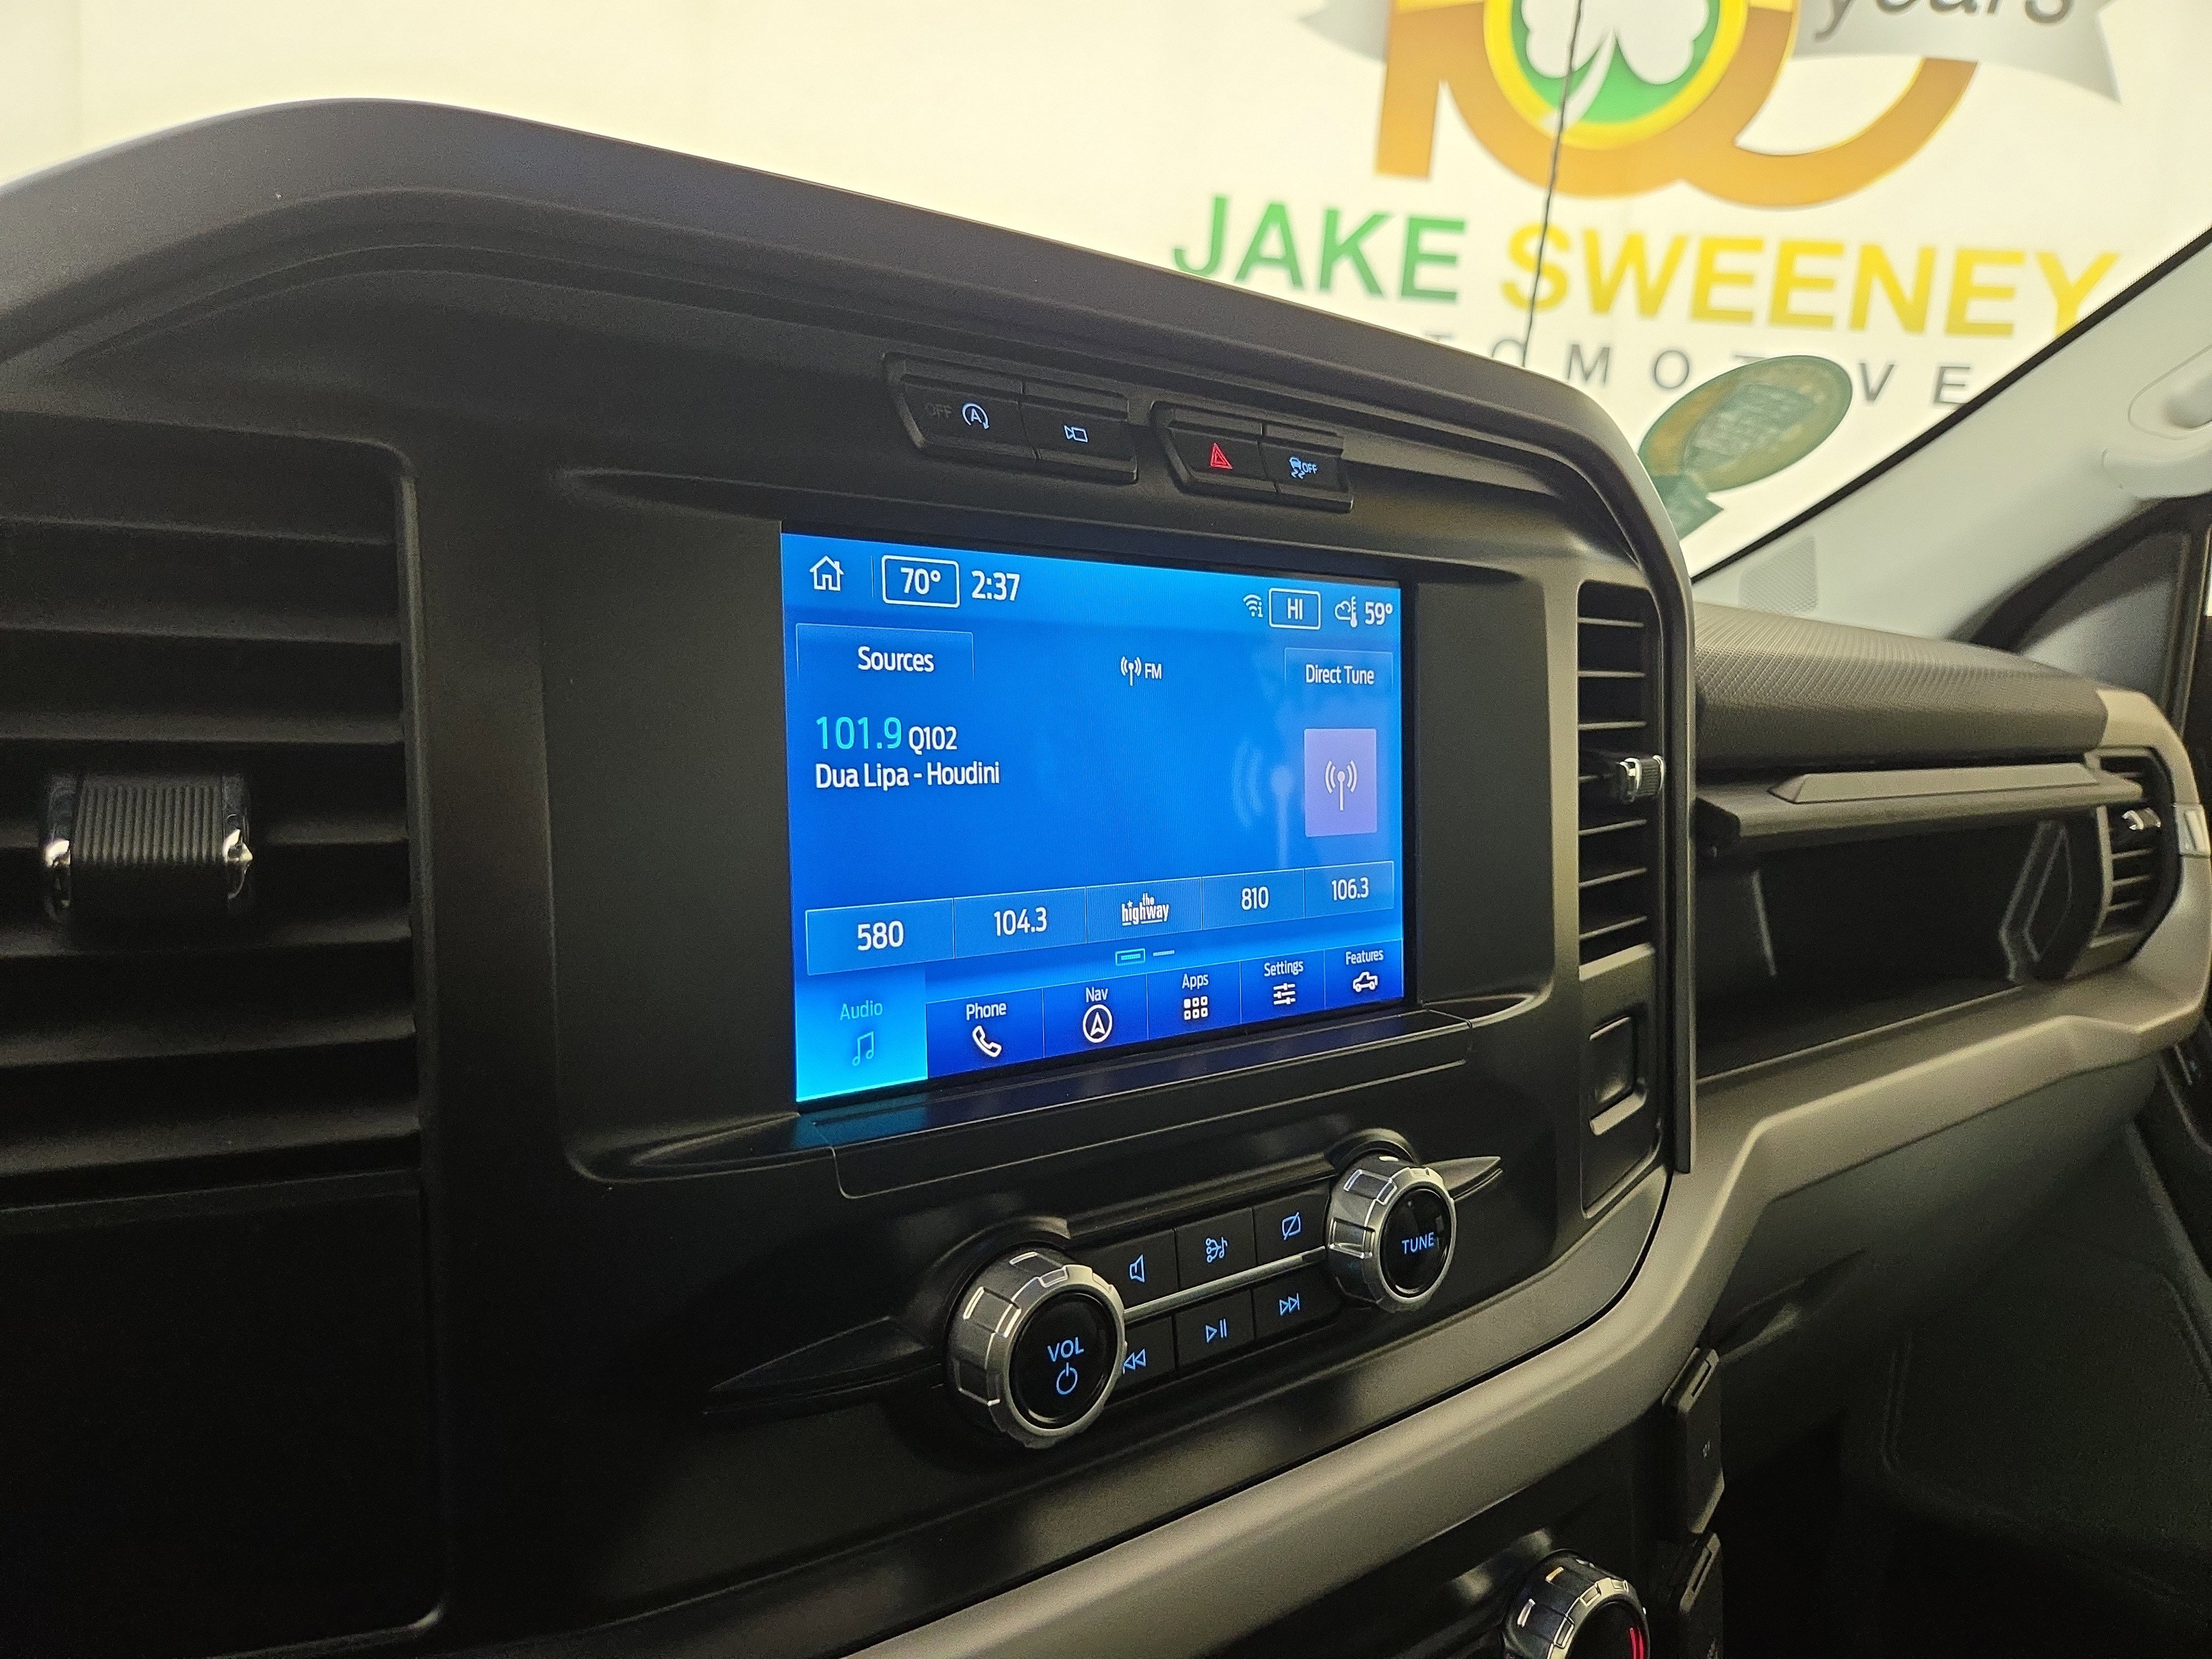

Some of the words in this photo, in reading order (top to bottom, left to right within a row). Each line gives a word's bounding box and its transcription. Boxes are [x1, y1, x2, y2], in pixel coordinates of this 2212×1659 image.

[1173, 196, 1467, 303] JAKE
[1500, 222, 2121, 337] SWEENEY
[1302, 462, 1317, 474] OFF
[900, 568, 941, 595] 70°
[972, 570, 1020, 601] 2:37
[1287, 597, 1303, 620] HI
[1365, 602, 1393, 626] 59°
[858, 646, 935, 672] Sources
[1144, 663, 1162, 680] FM
[1306, 665, 1341, 684] Direct
[1344, 666, 1375, 685] Tune
[816, 716, 902, 750] 101.9
[909, 726, 957, 755] Q102
[815, 763, 859, 789] Dua
[864, 763, 910, 791] Lipa
[927, 761, 1000, 786] Houdini
[1142, 892, 1154, 905] the
[1242, 886, 1269, 910] 810
[1332, 877, 1369, 902] 106.3
[994, 906, 1047, 937] 104.3
[1122, 901, 1169, 925] highway
[857, 921, 904, 951] 580
[1264, 959, 1304, 978] Settings
[1346, 948, 1384, 965] Features
[1182, 973, 1209, 990] Apps
[1085, 987, 1108, 1003] Nav
[840, 1000, 883, 1021] Audio
[966, 1003, 1007, 1021] Phone
[1401, 1231, 1435, 1255] TUNE
[1047, 1336, 1084, 1362] VOL
